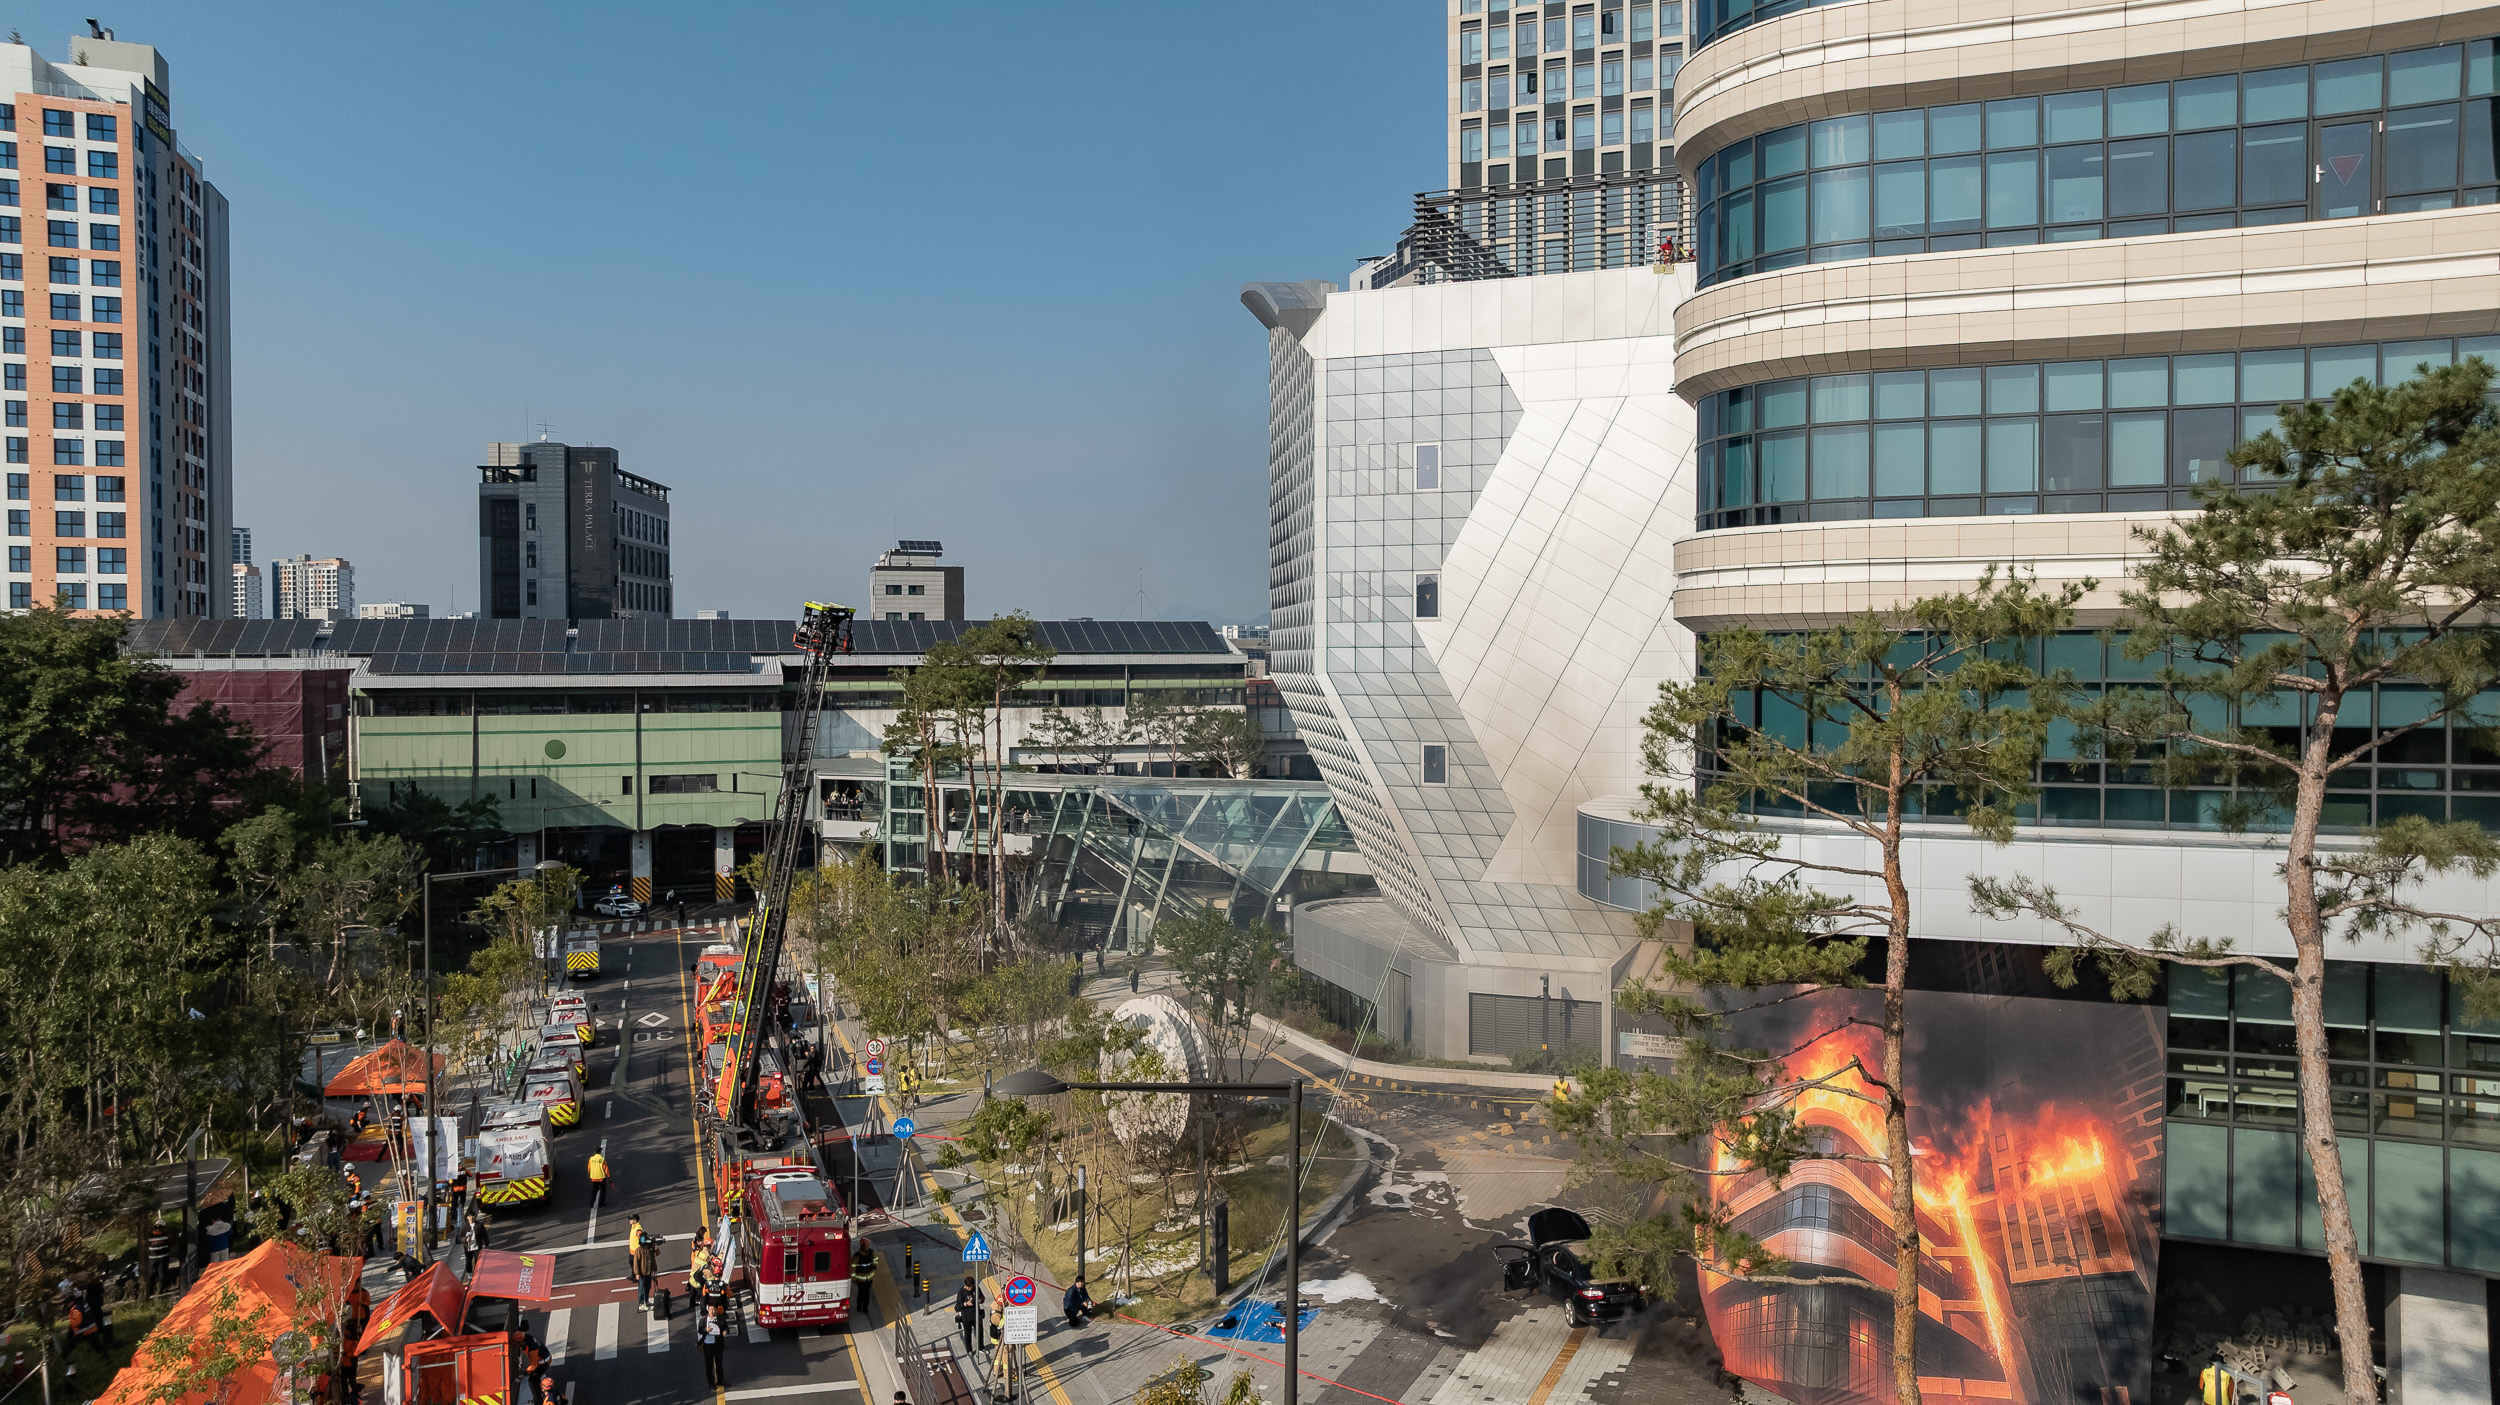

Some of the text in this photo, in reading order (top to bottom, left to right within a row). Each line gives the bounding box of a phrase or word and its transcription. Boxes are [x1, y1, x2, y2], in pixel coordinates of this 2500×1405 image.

[584, 478, 593, 552] TERRA PALACE
[870, 1044, 881, 1052] 30
[533, 1086, 555, 1098] 119
[495, 1135, 529, 1143] AMBULANCE
